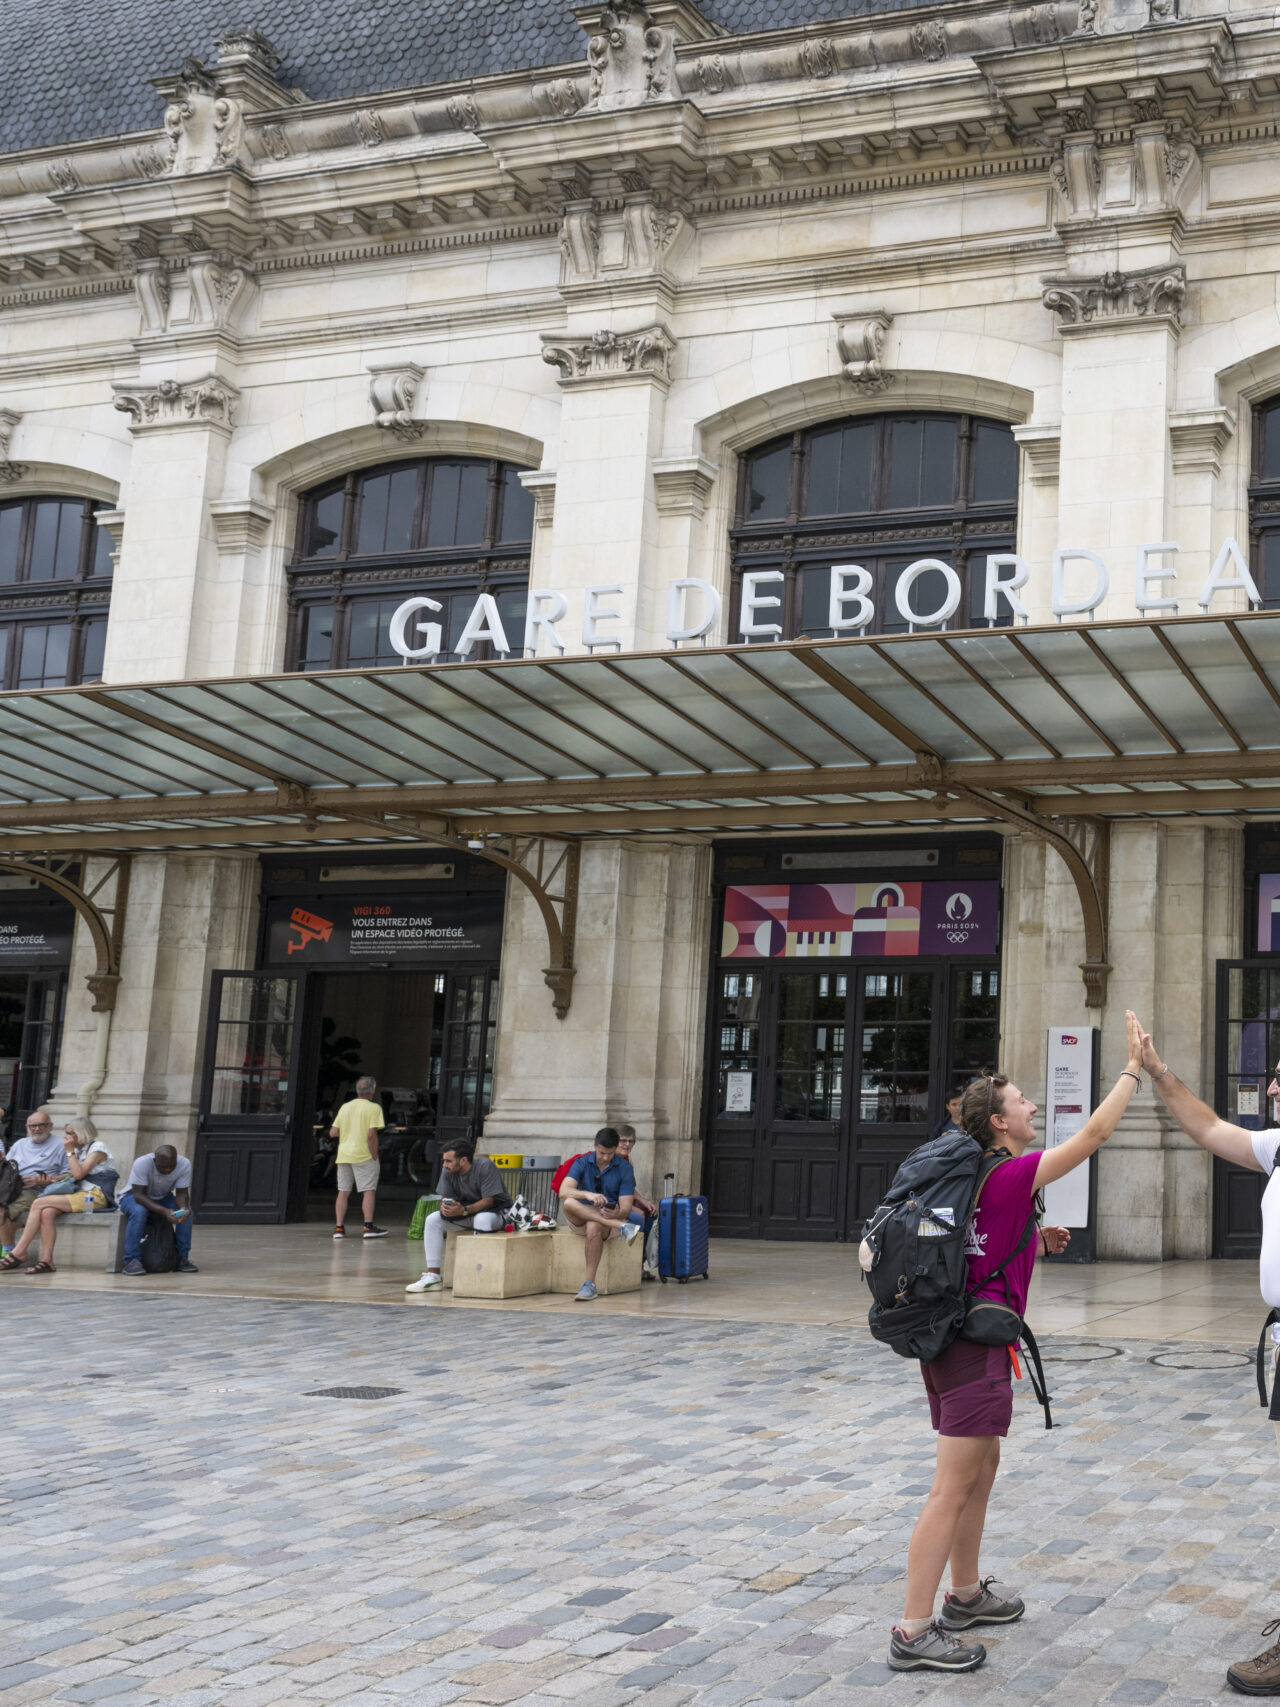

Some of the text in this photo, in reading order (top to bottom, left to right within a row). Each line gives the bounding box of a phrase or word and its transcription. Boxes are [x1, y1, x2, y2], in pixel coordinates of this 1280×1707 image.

[389, 584, 622, 660] GARE
[667, 569, 785, 641] DE
[353, 905, 392, 916] VIGI 360
[352, 917, 433, 927] VOUS ENTREZ DANS
[351, 926, 465, 938] UN ESPACE VIDÉO PROTÉGÉ.
